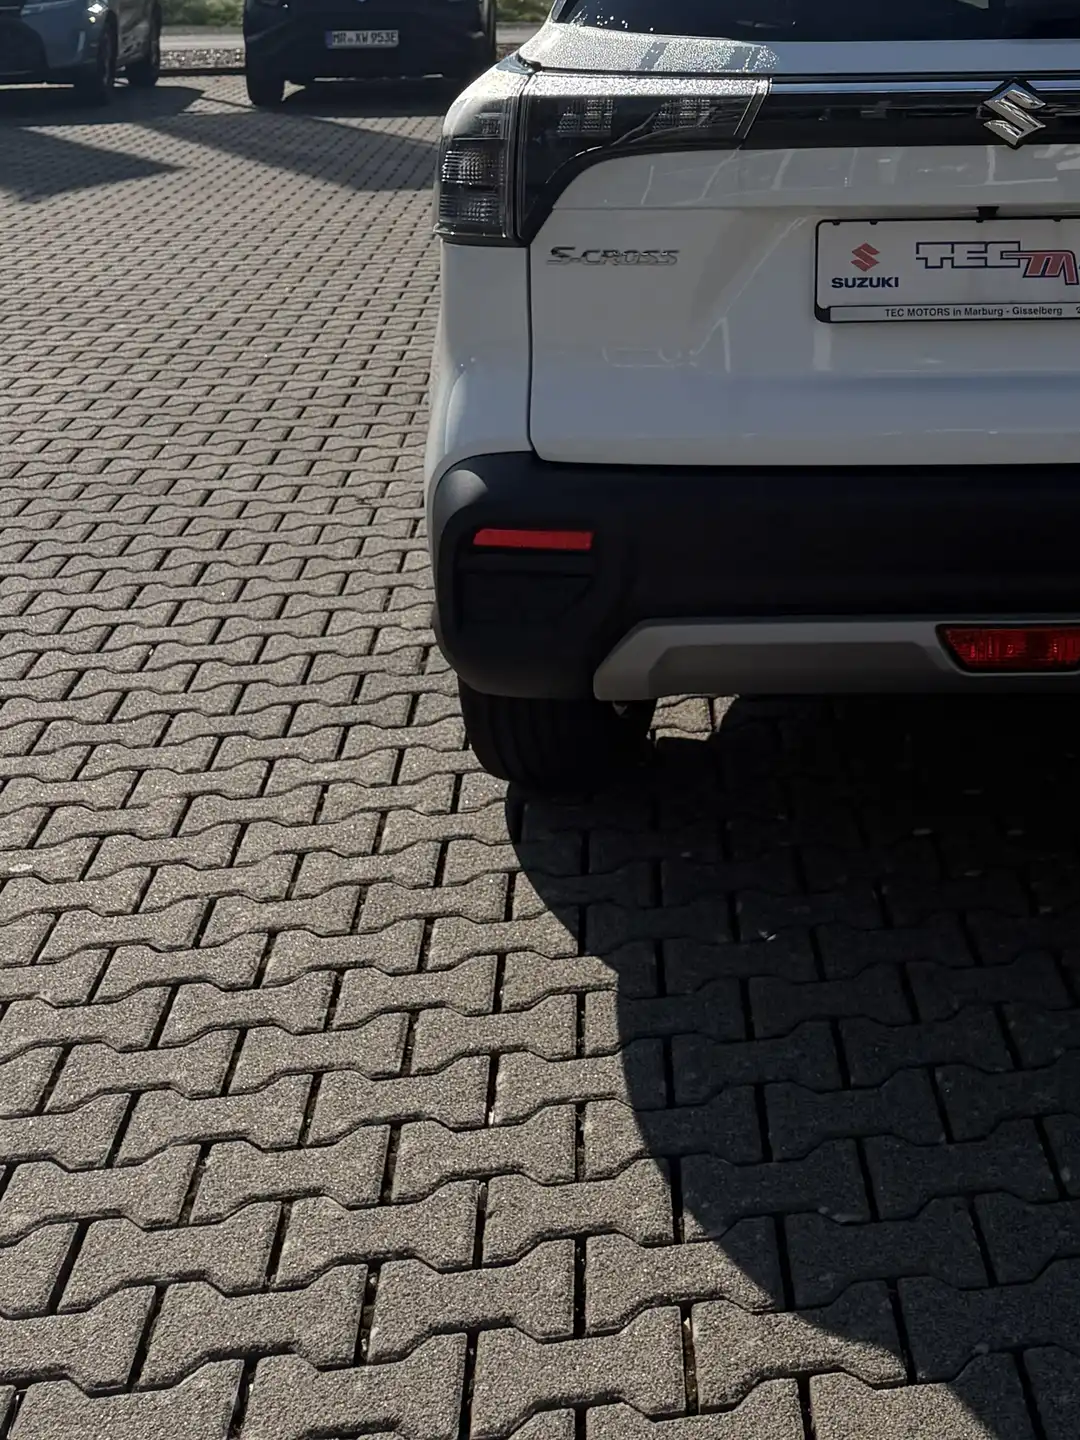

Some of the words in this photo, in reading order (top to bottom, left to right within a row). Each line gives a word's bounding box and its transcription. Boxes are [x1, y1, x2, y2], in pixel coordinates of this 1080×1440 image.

[916, 241, 1021, 269] TEC
[831, 276, 900, 289] SUZUKI
[885, 307, 905, 318] TEC
[907, 307, 950, 318] MOTORS
[952, 306, 962, 317] in
[964, 306, 1004, 318] Marburg
[1012, 305, 1063, 317] Gisselberg
